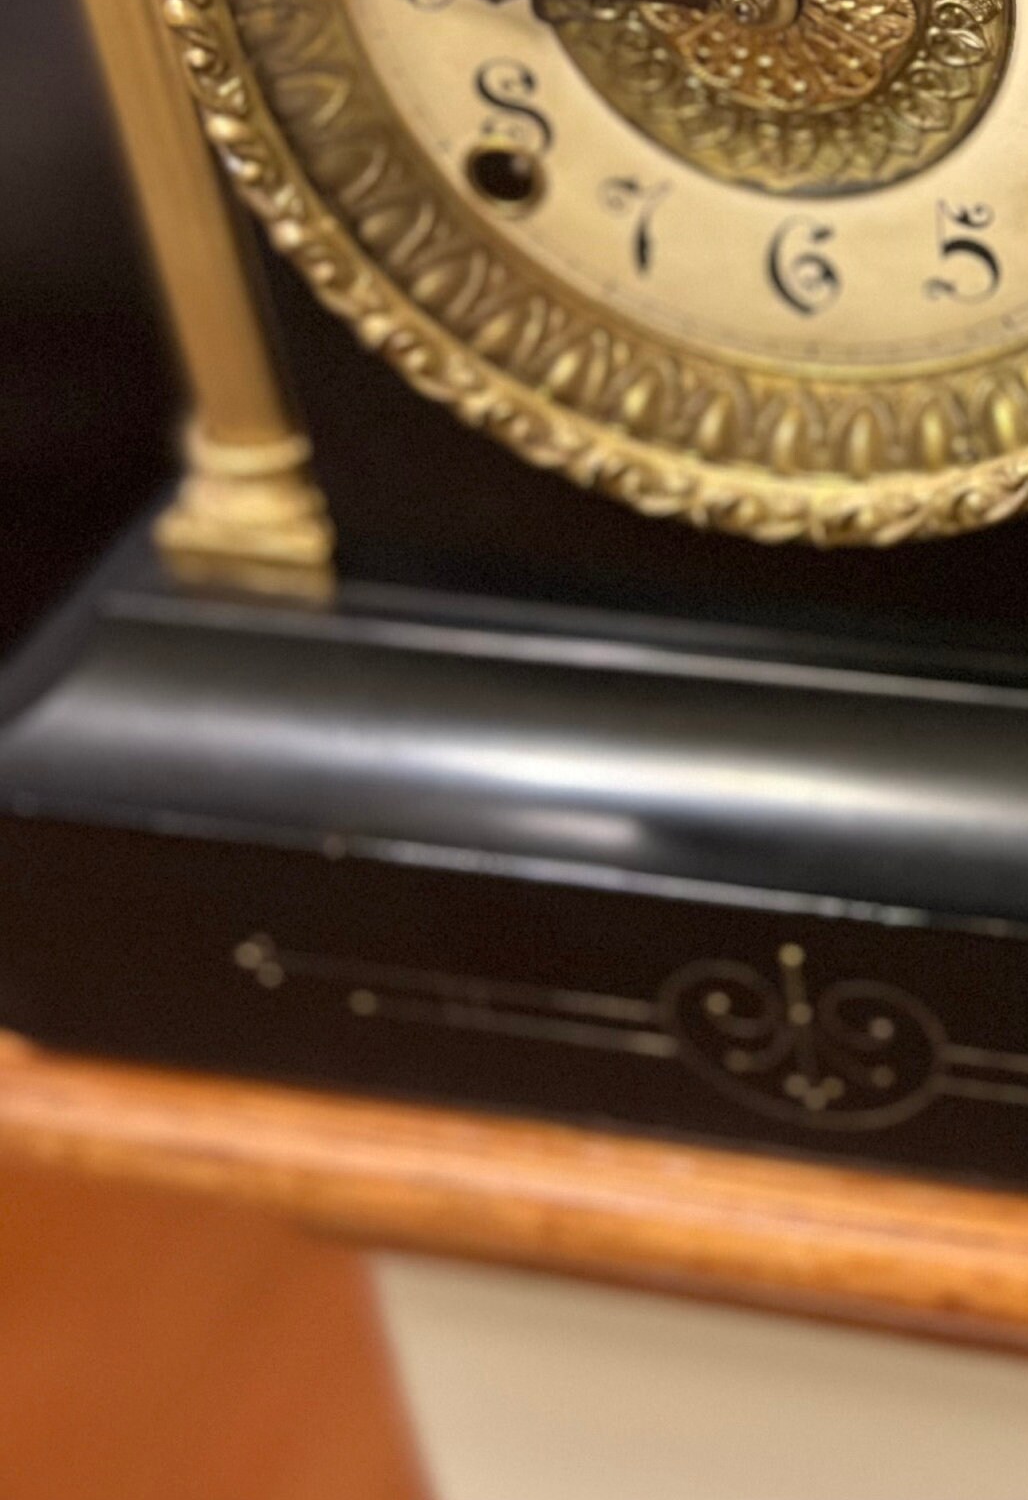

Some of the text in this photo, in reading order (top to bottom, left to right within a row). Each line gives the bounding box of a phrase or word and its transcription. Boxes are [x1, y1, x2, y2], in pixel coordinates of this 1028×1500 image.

[606, 176, 665, 280] 7
[767, 216, 845, 316] 6
[922, 200, 1002, 303] 5
